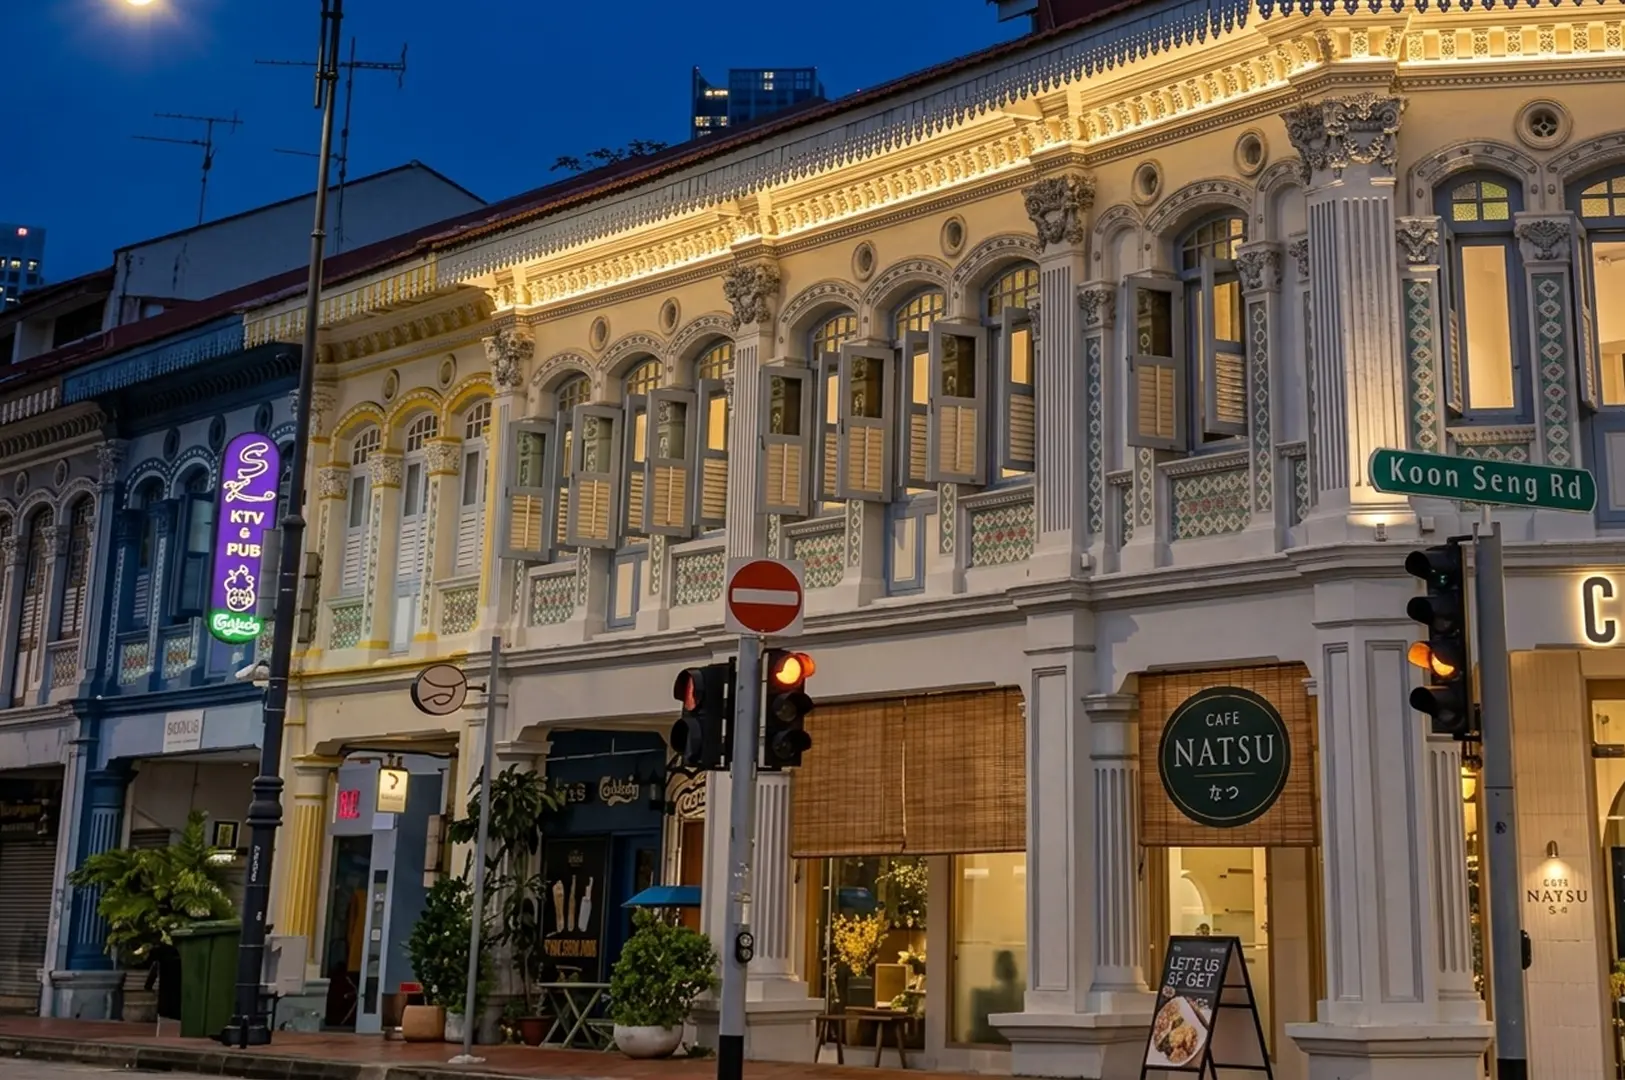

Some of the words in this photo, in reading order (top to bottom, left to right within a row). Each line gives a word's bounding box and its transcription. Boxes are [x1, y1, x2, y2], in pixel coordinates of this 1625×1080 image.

[1389, 456, 1459, 488] Koon
[1472, 465, 1538, 502] Seng
[1550, 473, 1582, 500] Rd
[230, 509, 265, 525] KTV
[226, 542, 261, 557] PUB
[1205, 711, 1240, 727] CAFE
[1174, 734, 1274, 767] NATSU
[1209, 784, 1239, 802] なつ
[1185, 971, 1216, 988] GET
